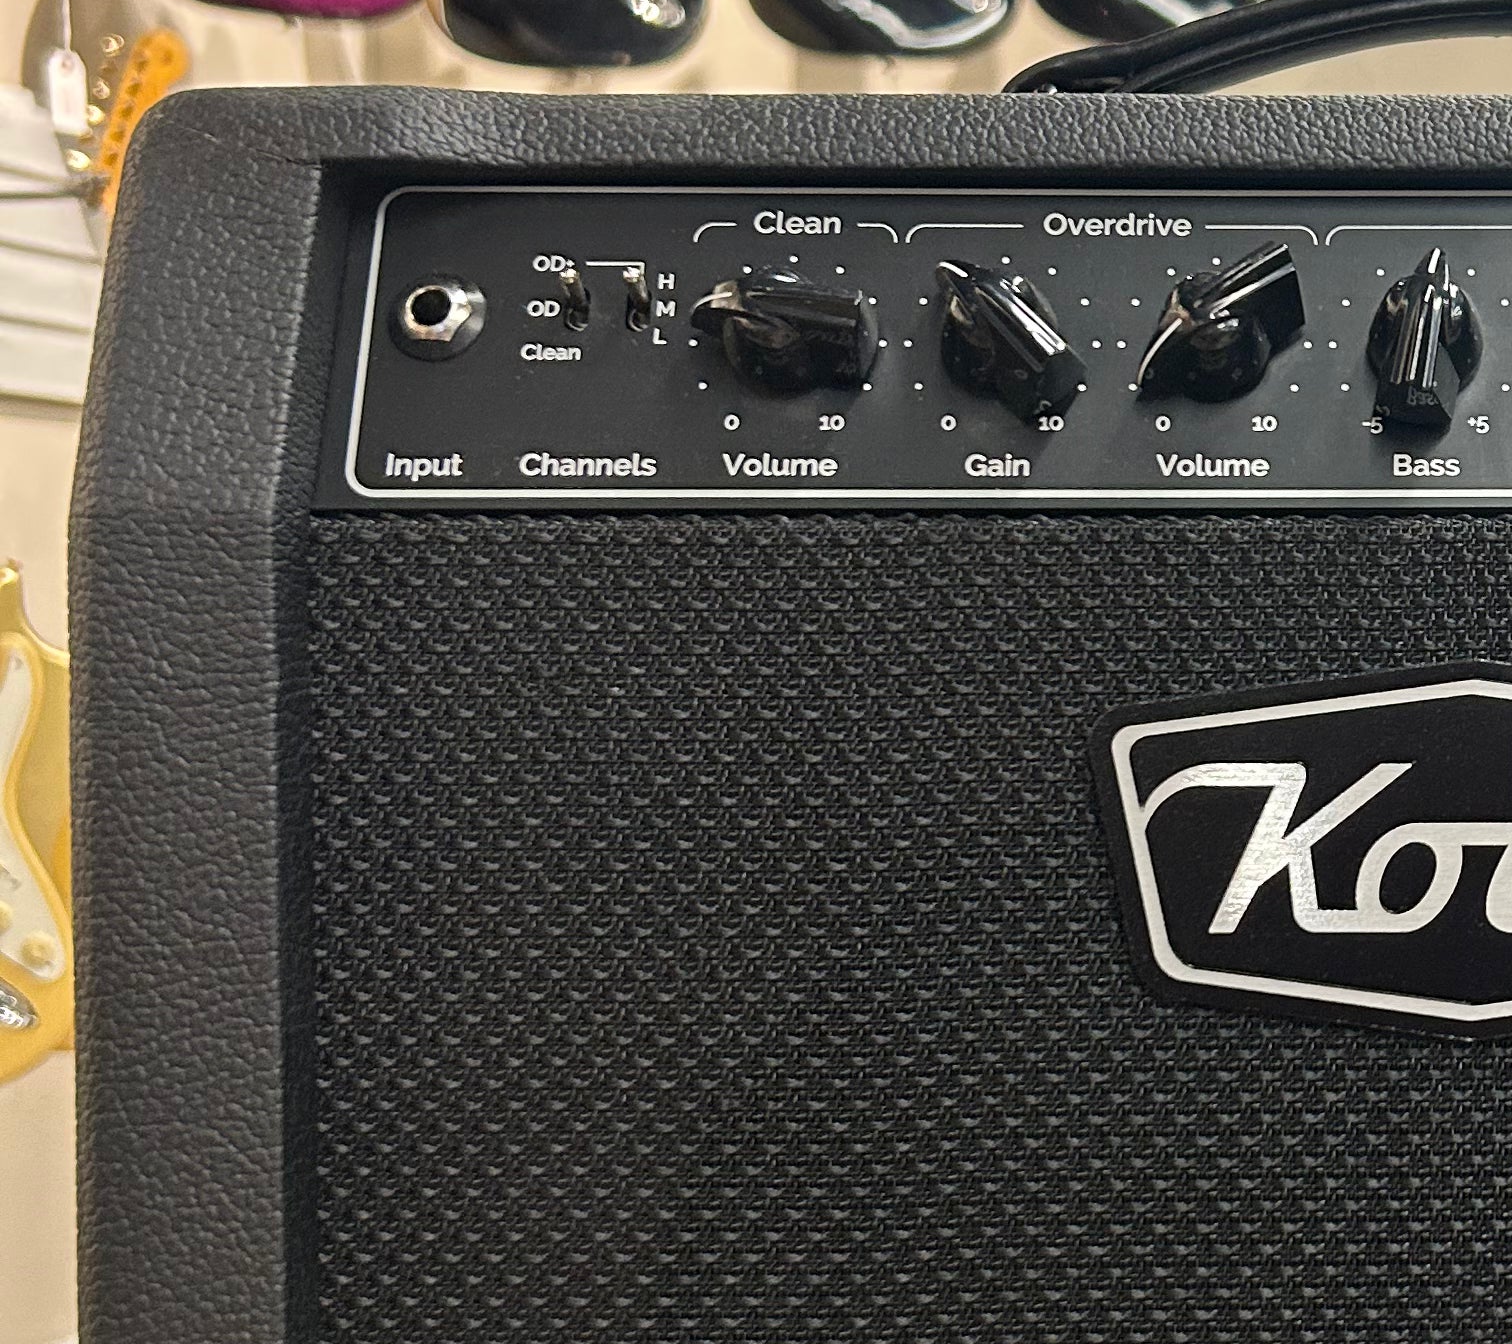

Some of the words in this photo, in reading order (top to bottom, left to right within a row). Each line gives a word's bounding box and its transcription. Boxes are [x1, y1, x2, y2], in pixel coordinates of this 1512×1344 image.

[753, 210, 842, 235] Clean
[1043, 212, 1193, 237] Overdrive
[657, 273, 675, 290] H
[526, 300, 561, 317] OD
[655, 300, 676, 317] M
[652, 327, 668, 345] L
[520, 343, 582, 361] Clean
[724, 414, 740, 431] 0
[819, 414, 845, 431] 10
[940, 415, 957, 431] 0
[1038, 415, 1065, 432] 10
[1155, 415, 1171, 432] 0
[1251, 415, 1278, 432] 10
[1361, 415, 1385, 435] -5
[1467, 415, 1490, 434] +5
[385, 452, 464, 482] Input
[519, 452, 657, 477] Channels
[722, 452, 838, 477] Volume
[964, 453, 1030, 477] Gain
[1156, 453, 1270, 477] Volume
[1393, 453, 1461, 477] Bass
